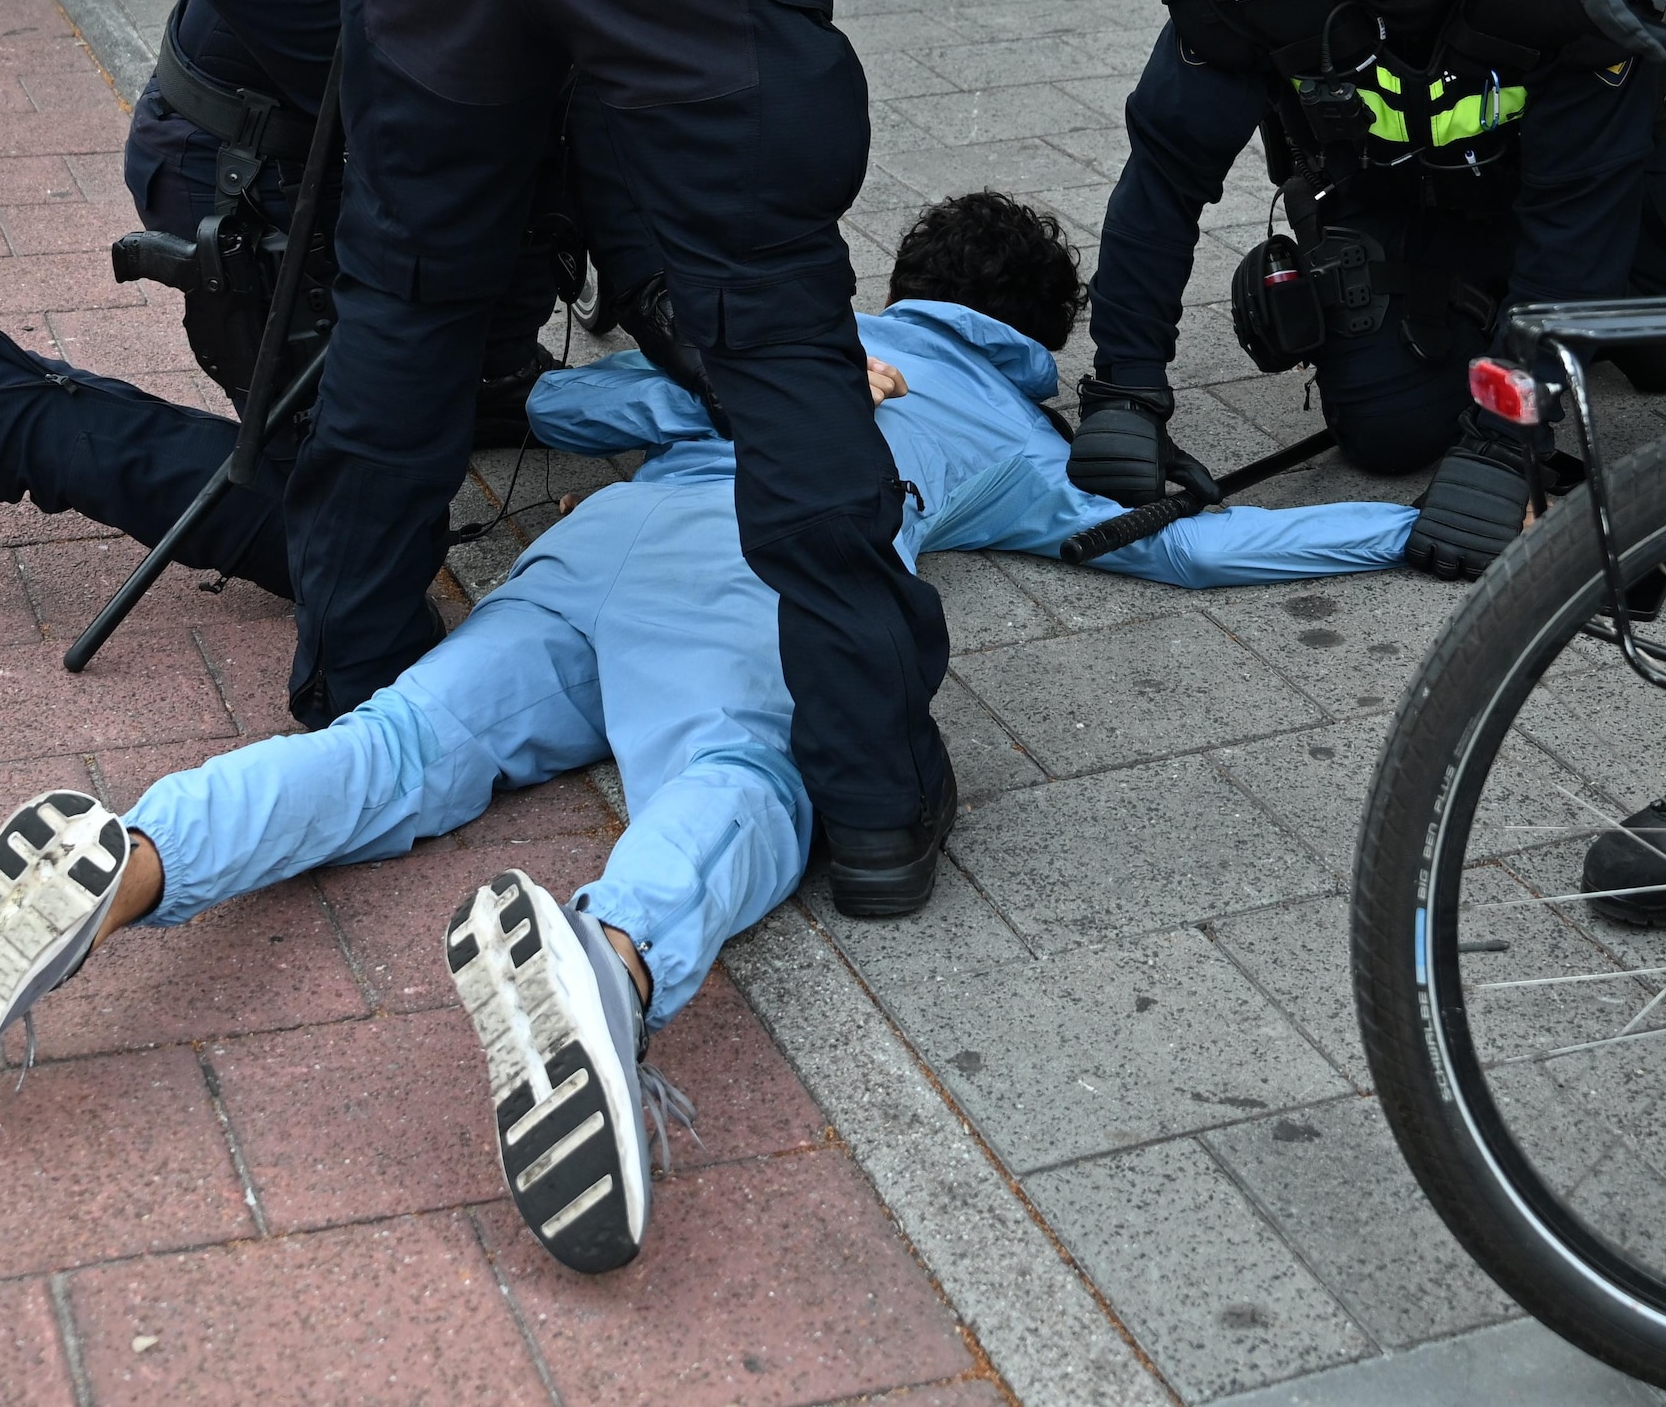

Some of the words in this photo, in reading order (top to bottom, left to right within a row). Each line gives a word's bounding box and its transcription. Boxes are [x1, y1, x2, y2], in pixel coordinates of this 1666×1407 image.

[1417, 868, 1429, 900] BIG
[1434, 764, 1456, 814] PLUS
[1418, 991, 1452, 1102] SCHWALBE
